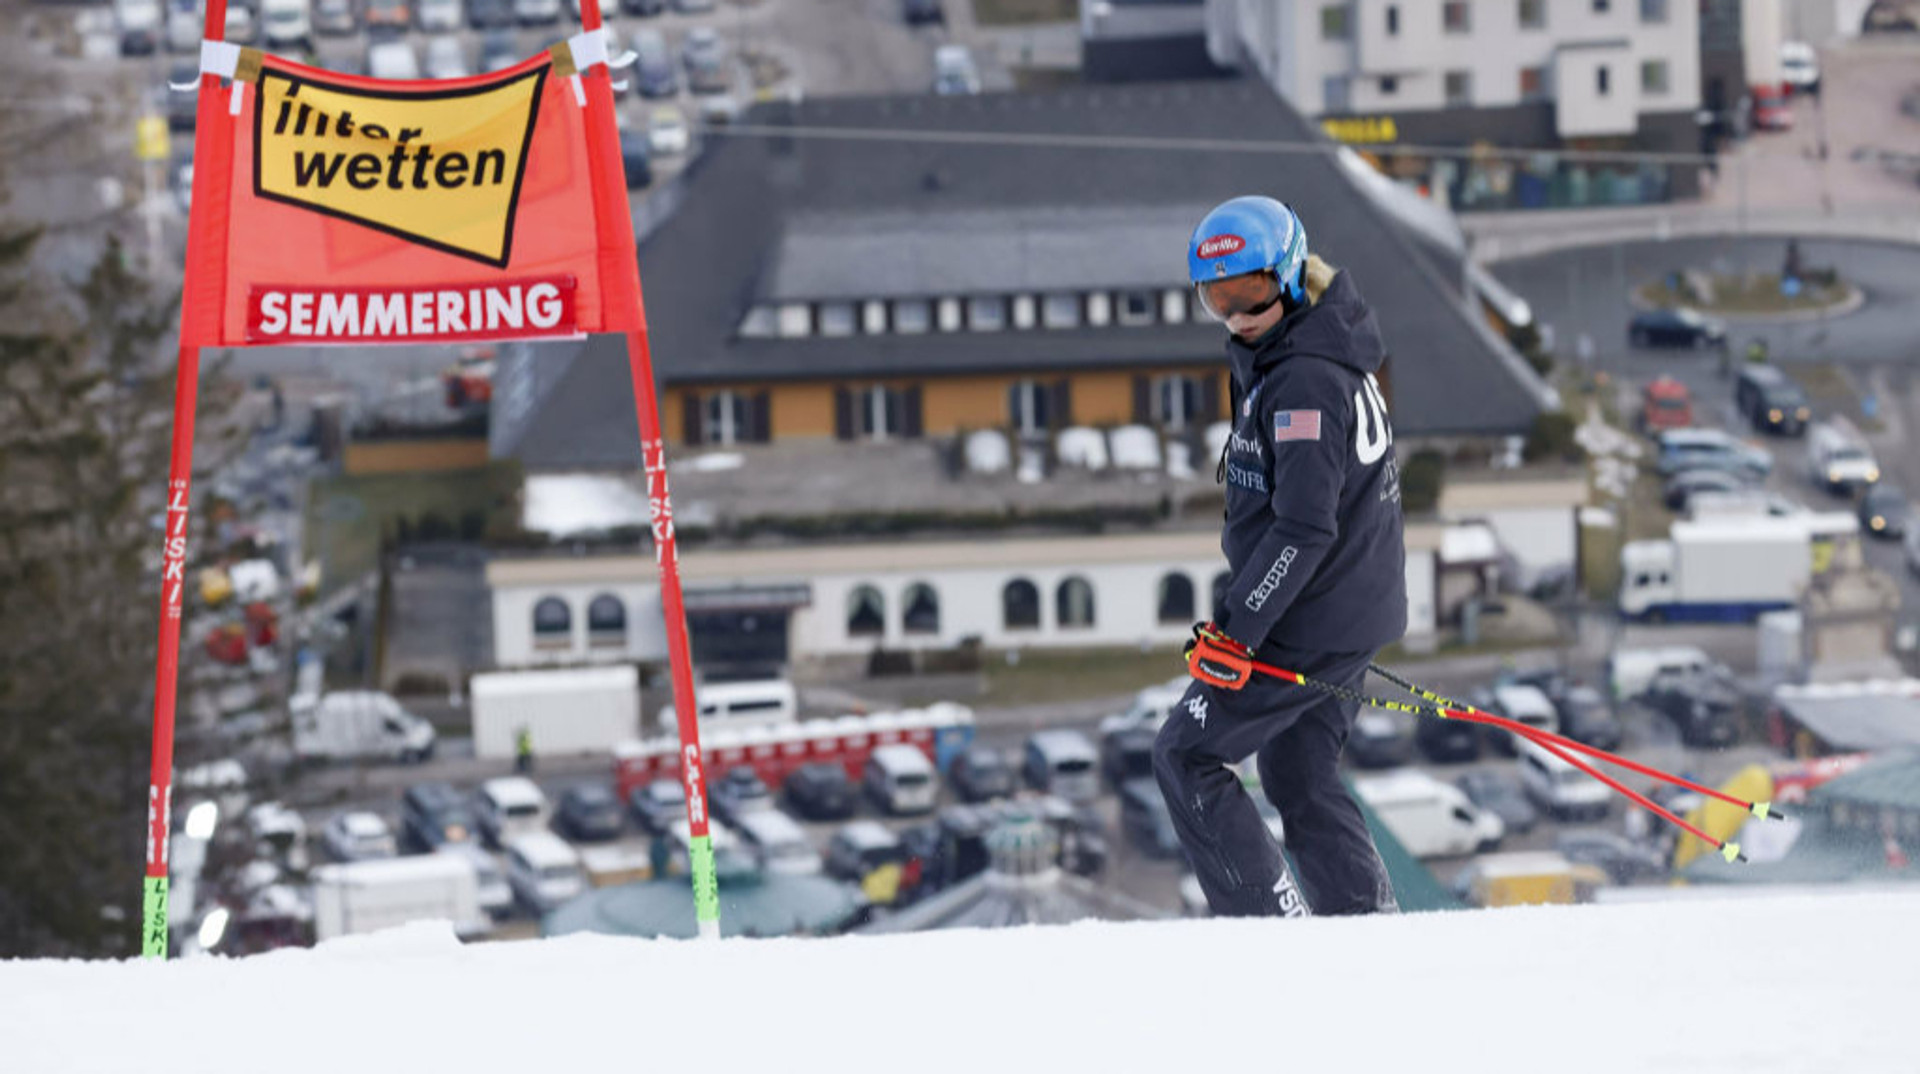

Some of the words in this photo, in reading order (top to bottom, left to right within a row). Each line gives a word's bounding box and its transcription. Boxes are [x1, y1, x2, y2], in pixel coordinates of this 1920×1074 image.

[274, 82, 423, 146] inter
[294, 143, 507, 190] wetten
[259, 282, 564, 337] SEMMERING
[166, 490, 189, 605] LISKI
[1245, 545, 1299, 613] Kappa
[151, 879, 167, 956] LISKI
